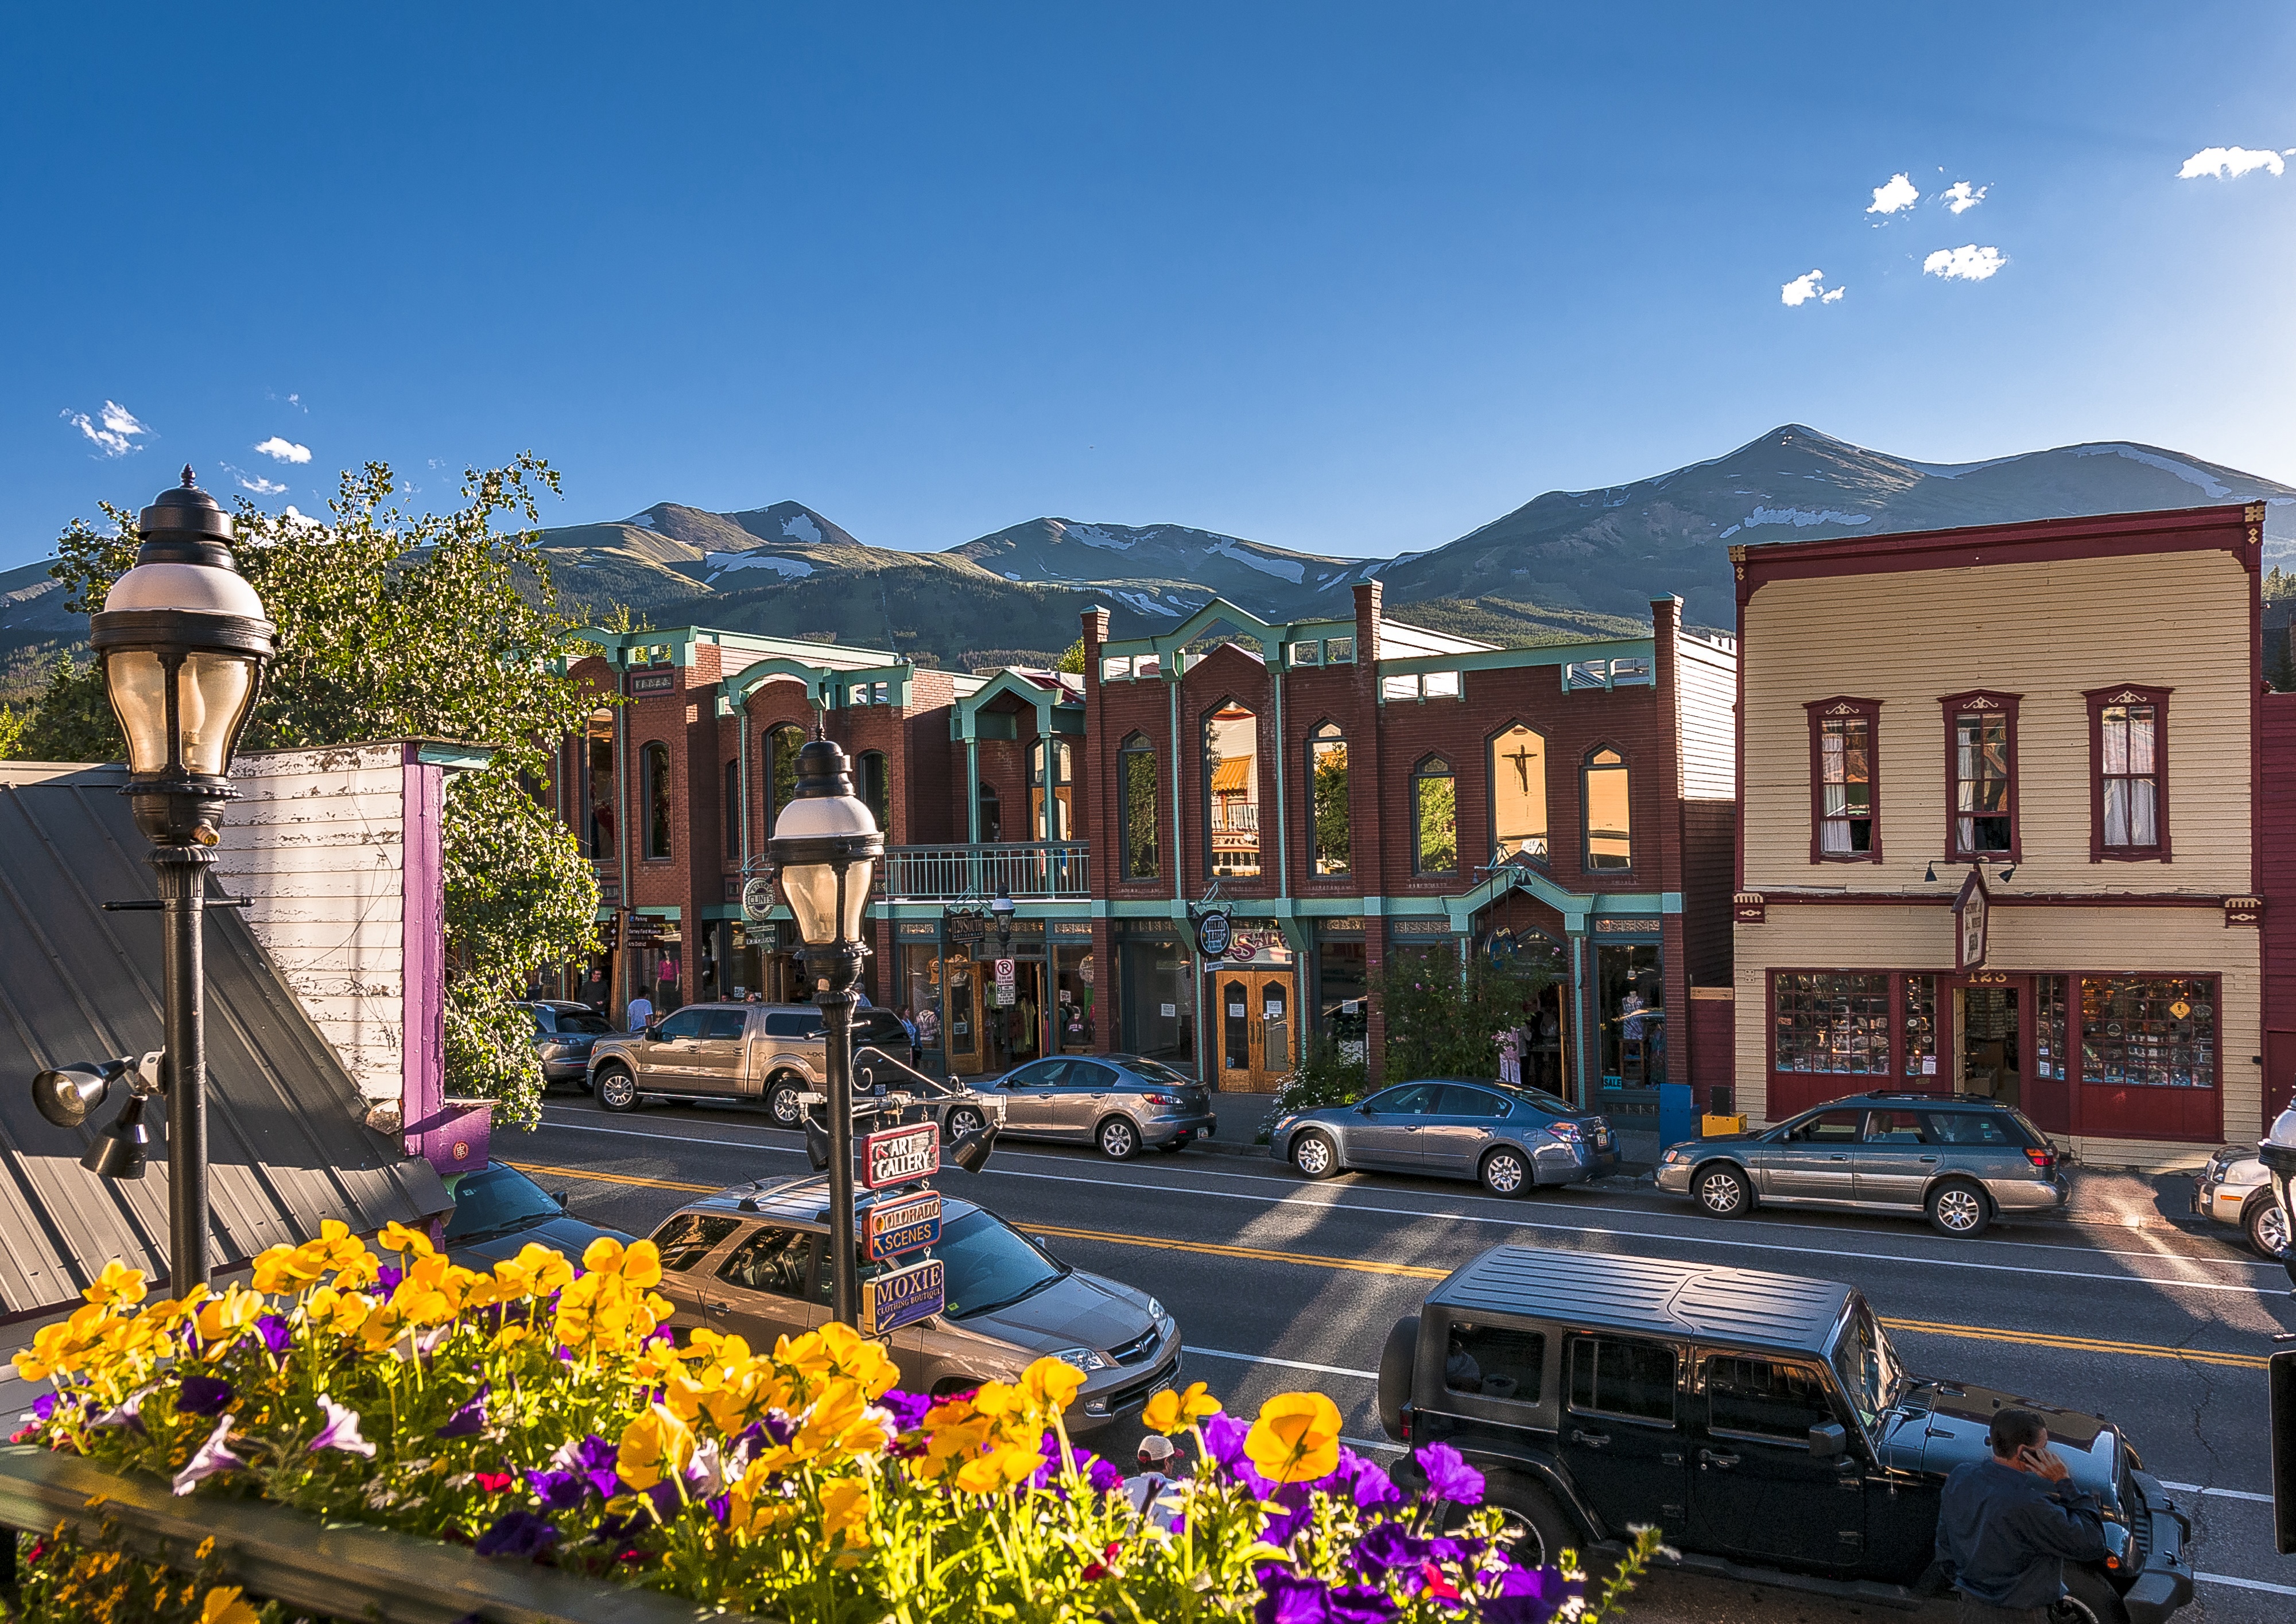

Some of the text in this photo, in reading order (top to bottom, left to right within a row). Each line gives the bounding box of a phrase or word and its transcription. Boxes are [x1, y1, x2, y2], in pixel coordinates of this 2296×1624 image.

[1969, 972, 2007, 982] 123
[1604, 1078, 1622, 1087] SALE
[890, 1136, 914, 1157] ART
[877, 1151, 929, 1179] GALLERY
[874, 1202, 940, 1235] COLORADO
[885, 1223, 931, 1250] SCENES
[877, 1265, 941, 1306] MOXIE
[877, 1299, 909, 1315] CLOTHING
